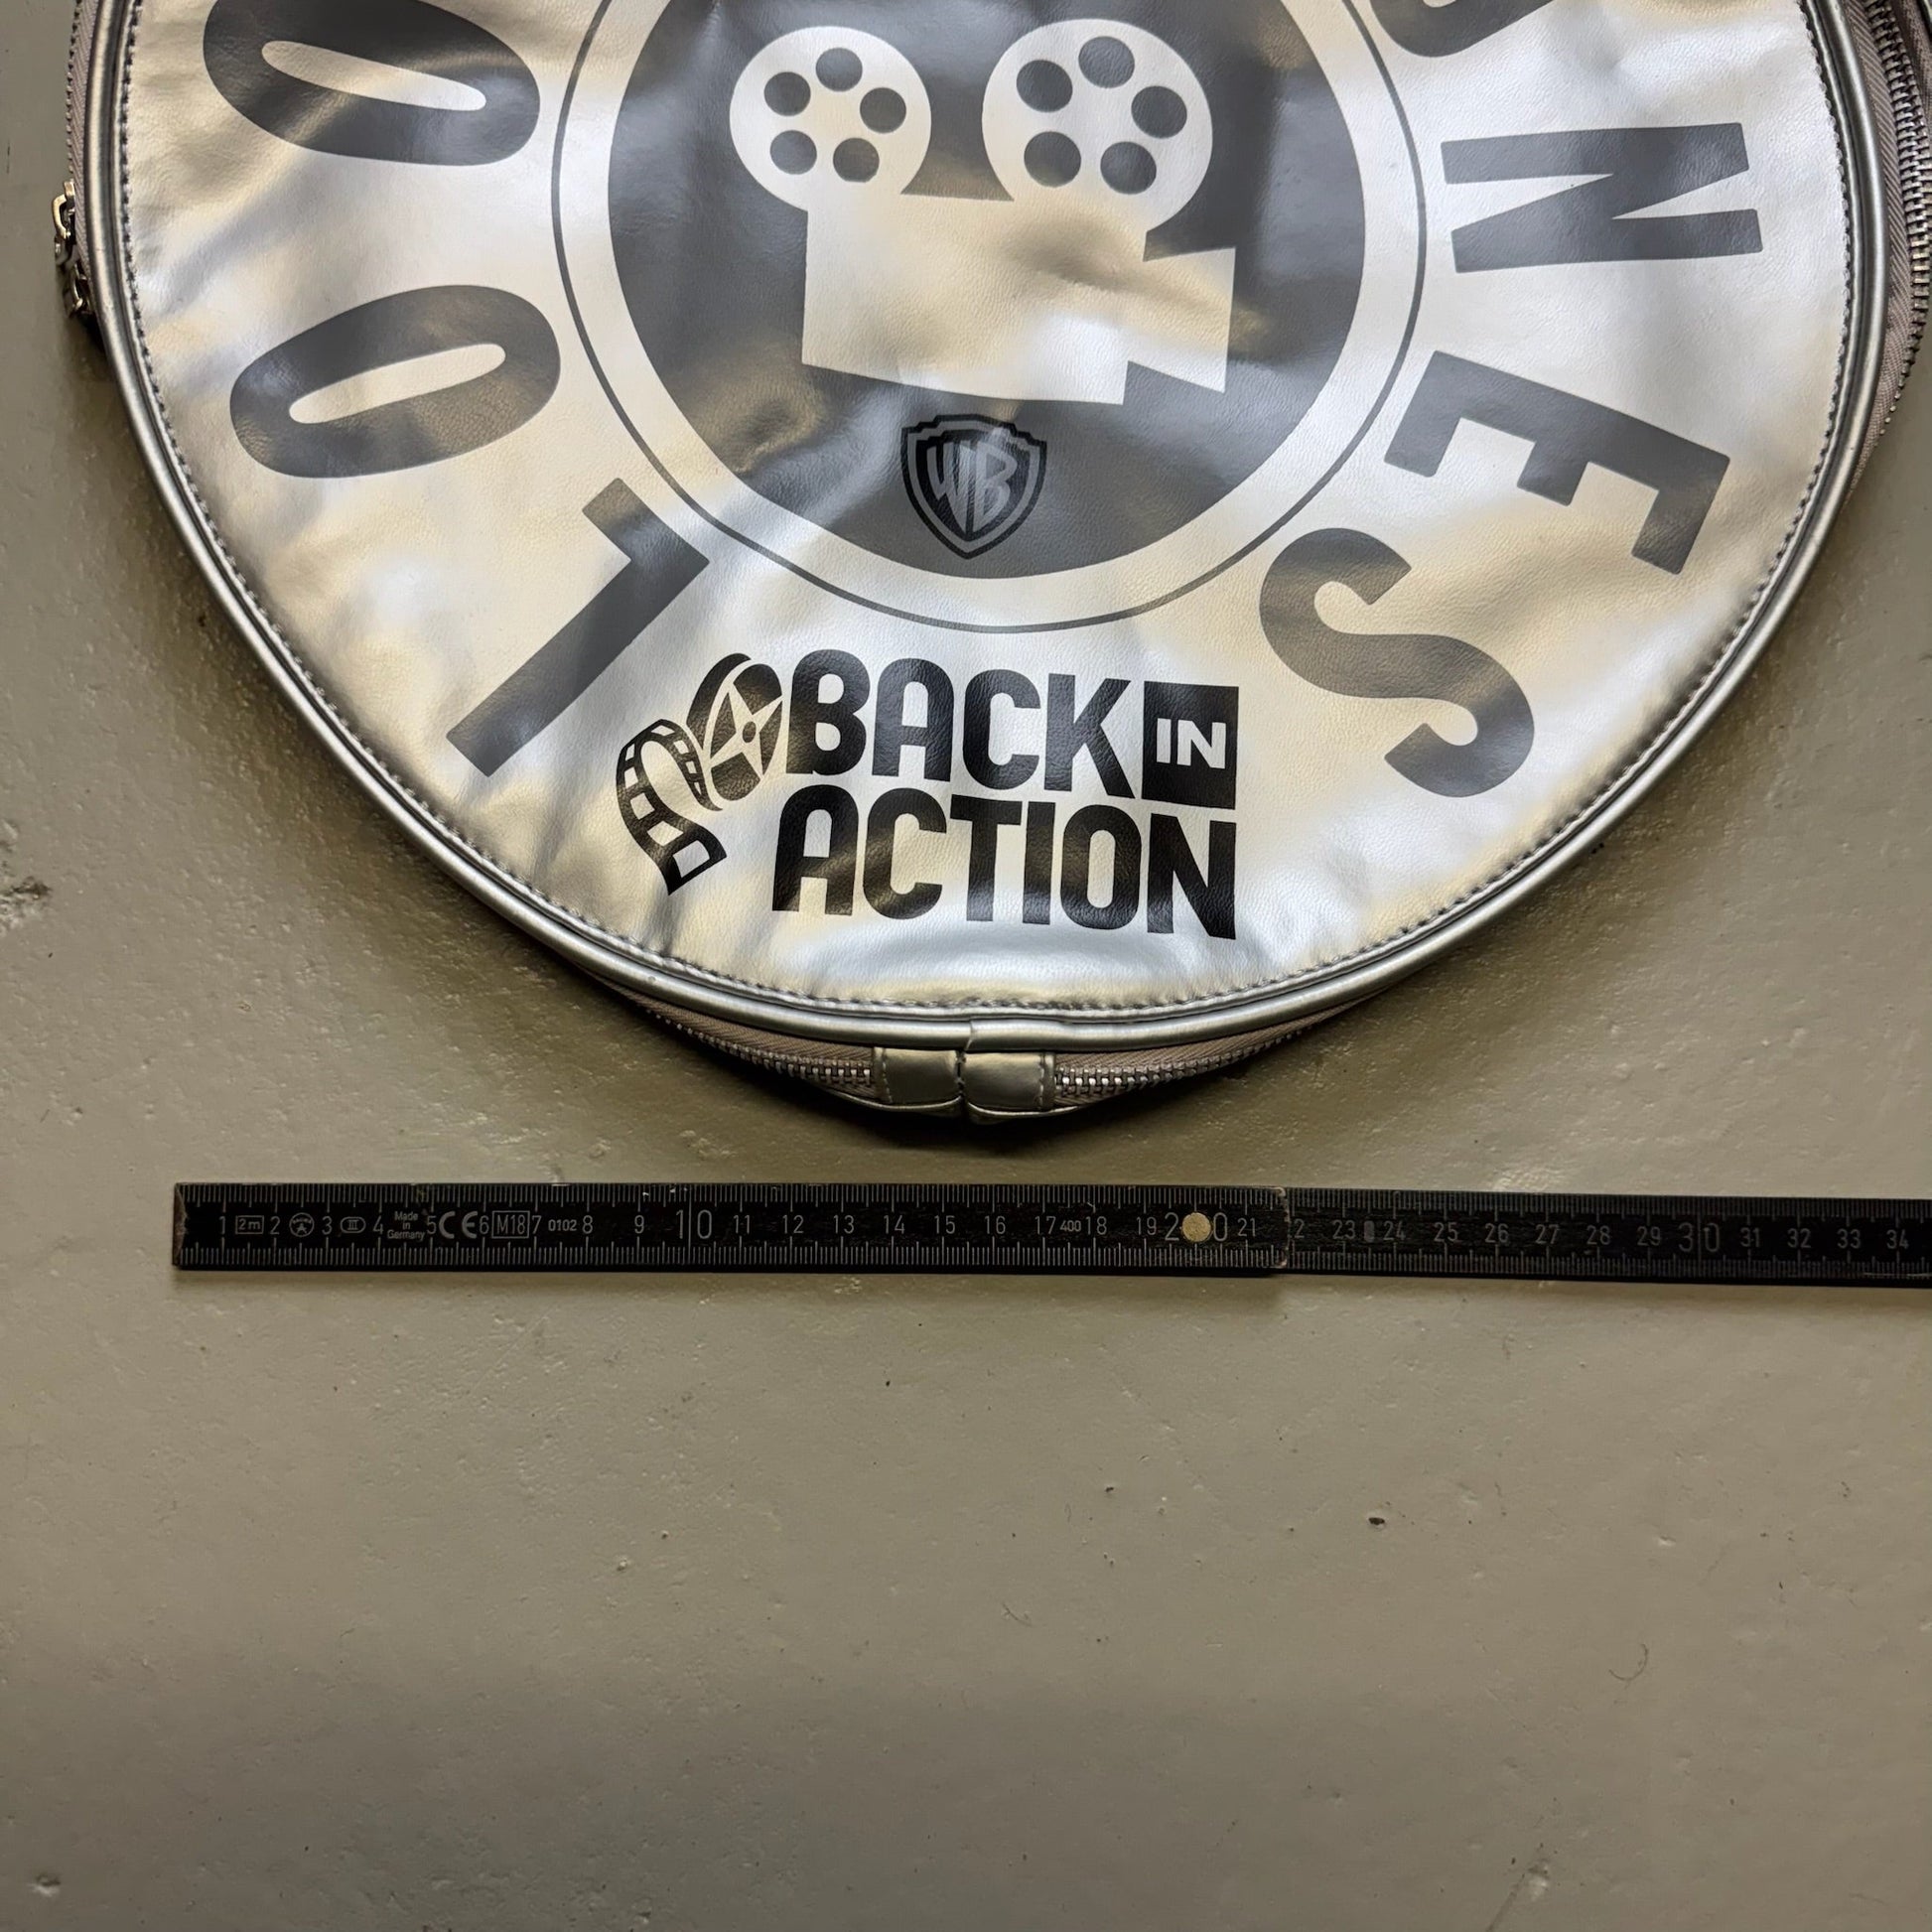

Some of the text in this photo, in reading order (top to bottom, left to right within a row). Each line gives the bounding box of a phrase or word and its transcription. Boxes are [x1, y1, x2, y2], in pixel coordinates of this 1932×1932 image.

[786, 649, 1227, 799] BACK IN
[771, 784, 1237, 940] ACTION
[219, 1216, 225, 1235] 1
[270, 1216, 281, 1235] 2
[322, 1215, 333, 1235] 3
[372, 1215, 383, 1235] 4
[394, 1210, 419, 1222] Made
[402, 1220, 411, 1230] in
[387, 1229, 426, 1242] Germany
[427, 1215, 437, 1235] 5
[439, 1210, 479, 1239] CE
[479, 1214, 489, 1235] 6
[496, 1216, 525, 1234] M18
[532, 1215, 541, 1234] 7
[548, 1219, 577, 1232] 0102
[582, 1214, 593, 1234] 8
[634, 1214, 644, 1234] 9
[676, 1210, 713, 1240] 10
[733, 1214, 751, 1234] 11
[782, 1214, 804, 1234] 12
[833, 1214, 855, 1234] 13
[883, 1214, 905, 1234] 14
[934, 1214, 956, 1234] 15
[984, 1215, 1006, 1235] 16
[1035, 1215, 1056, 1235] 17
[1086, 1216, 1107, 1235] 18
[1136, 1216, 1158, 1236] 19
[1237, 1217, 1257, 1237] 21
[1290, 1218, 1306, 1239] 2
[1332, 1219, 1356, 1240] 23
[1383, 1220, 1406, 1241] 24
[1434, 1221, 1458, 1242] 25
[1485, 1222, 1509, 1243] 26
[1536, 1224, 1560, 1244] 27
[1587, 1225, 1610, 1246] 28
[1637, 1226, 1662, 1247] 29
[1678, 1222, 1721, 1253] 30
[1739, 1227, 1760, 1248] 31
[1787, 1228, 1811, 1249] 32
[1838, 1228, 1862, 1249] 33
[1886, 1229, 1909, 1250] 34
